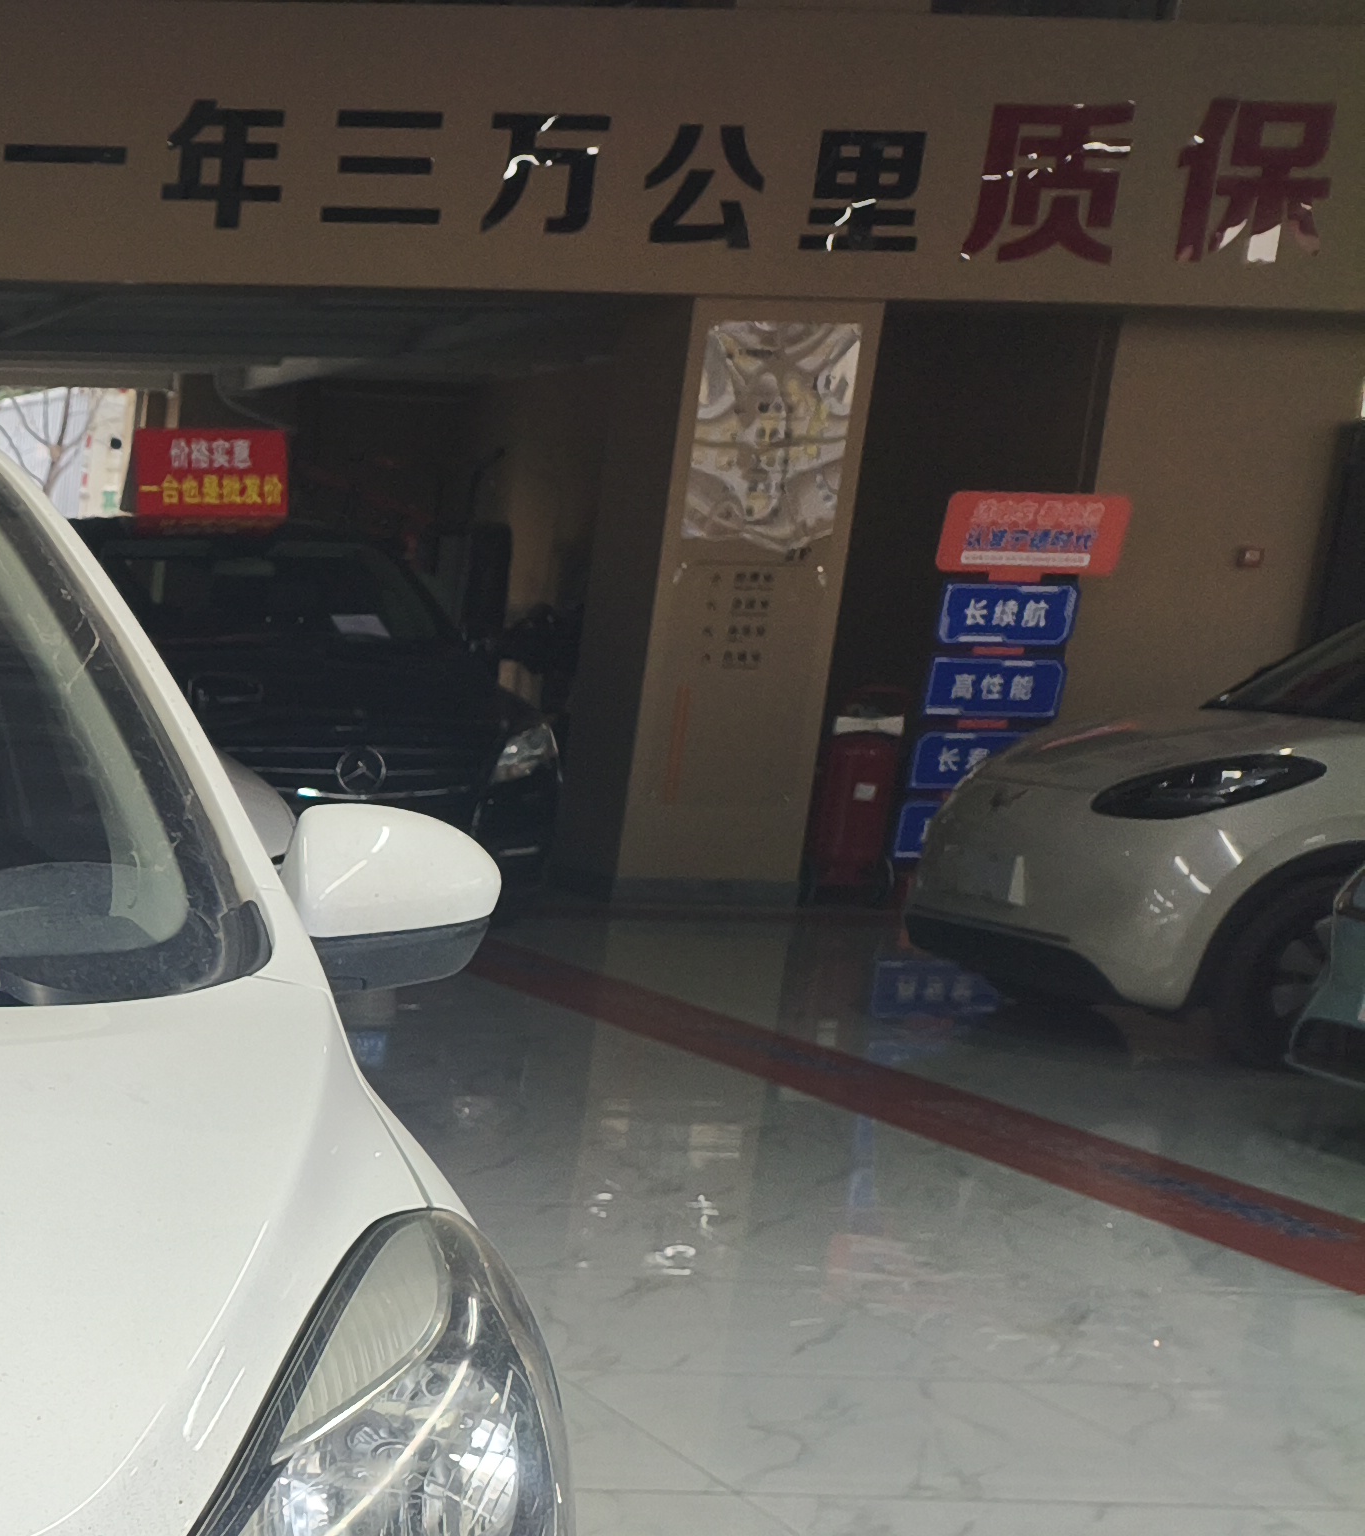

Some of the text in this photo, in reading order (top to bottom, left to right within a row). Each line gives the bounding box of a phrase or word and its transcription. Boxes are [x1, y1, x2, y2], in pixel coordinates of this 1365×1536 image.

[170, 437, 252, 469] 价格实惠
[138, 474, 283, 505] 一台也是批发价
[964, 598, 1049, 628] 长续航
[950, 673, 1034, 701] 高性能
